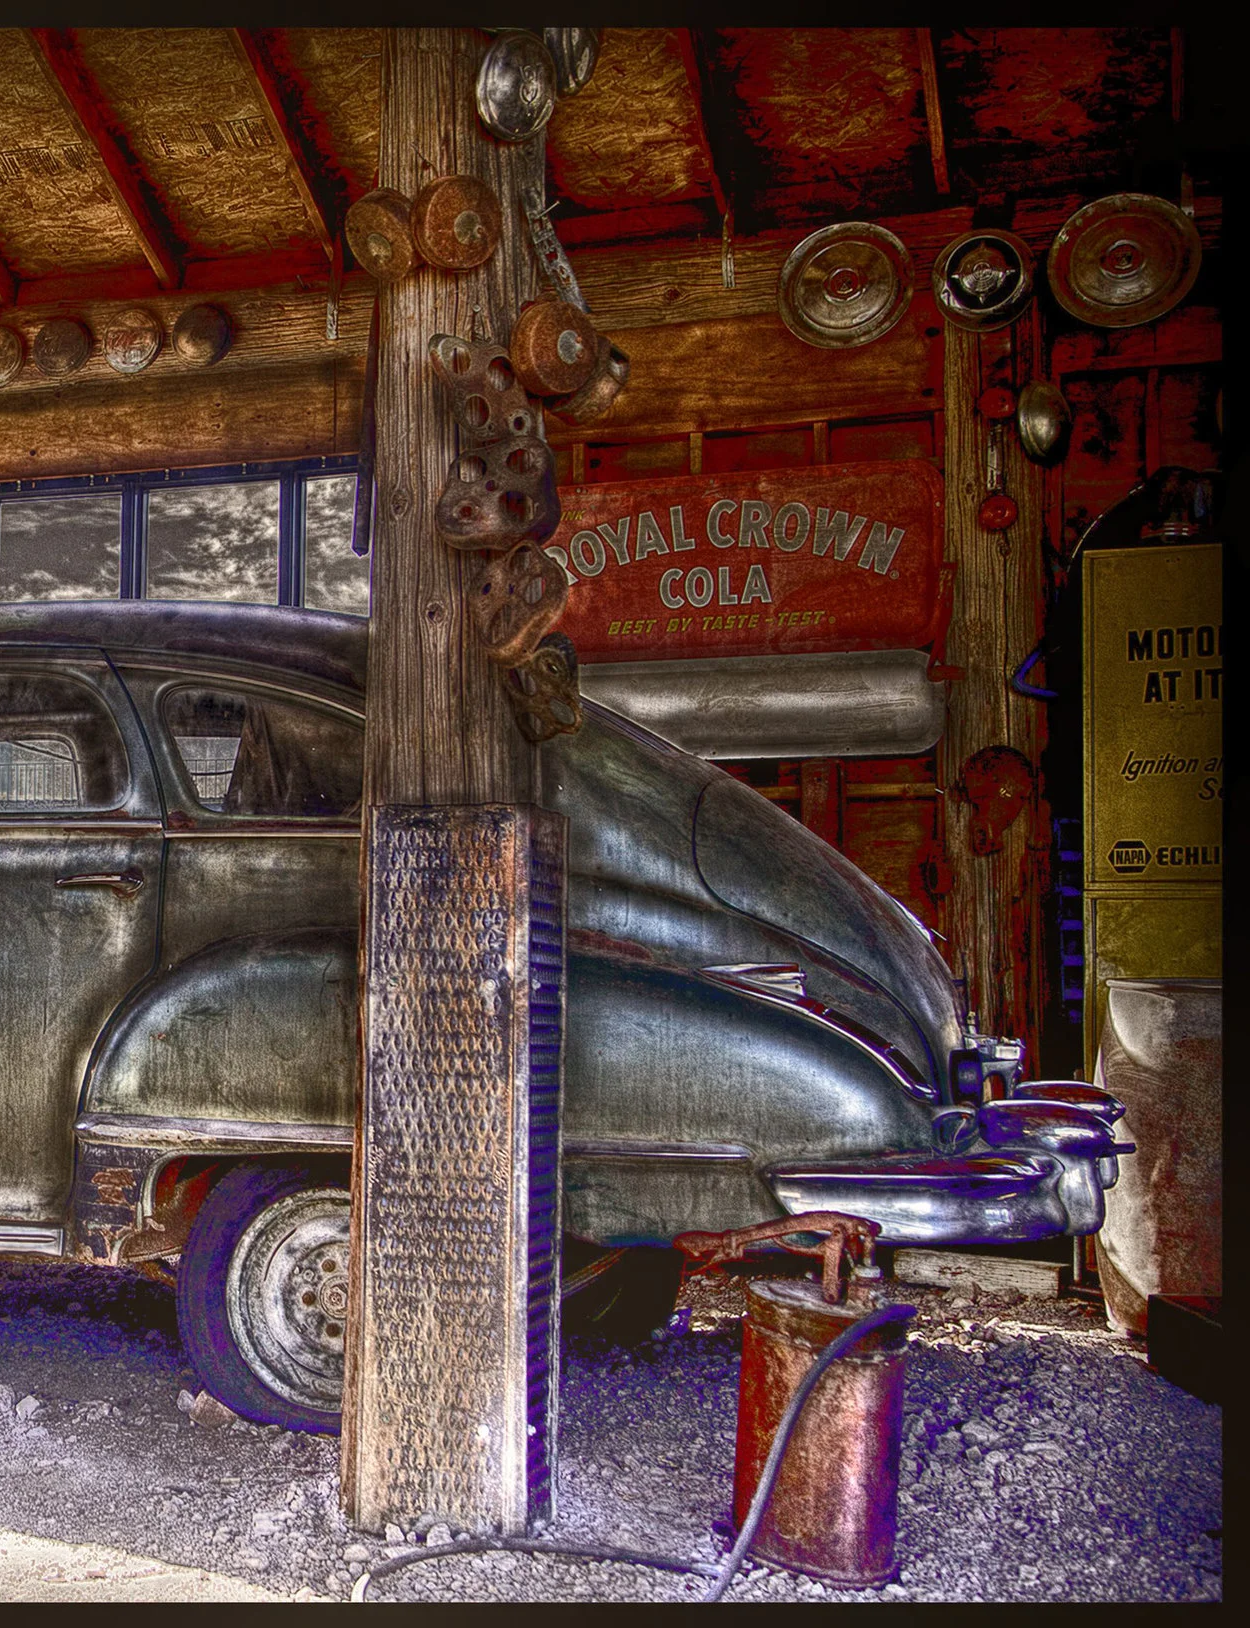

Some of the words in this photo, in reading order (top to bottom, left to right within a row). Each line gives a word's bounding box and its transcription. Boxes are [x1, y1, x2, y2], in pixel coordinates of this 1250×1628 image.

[560, 509, 586, 521] INK
[706, 500, 906, 576] CROWN
[659, 564, 772, 608] COLA
[607, 619, 657, 636] BEST
[666, 616, 693, 633] BY
[1128, 626, 1223, 661] MOTO
[1144, 671, 1181, 704] AT
[1121, 751, 1198, 781] Ignition
[1115, 850, 1144, 866] NAPA
